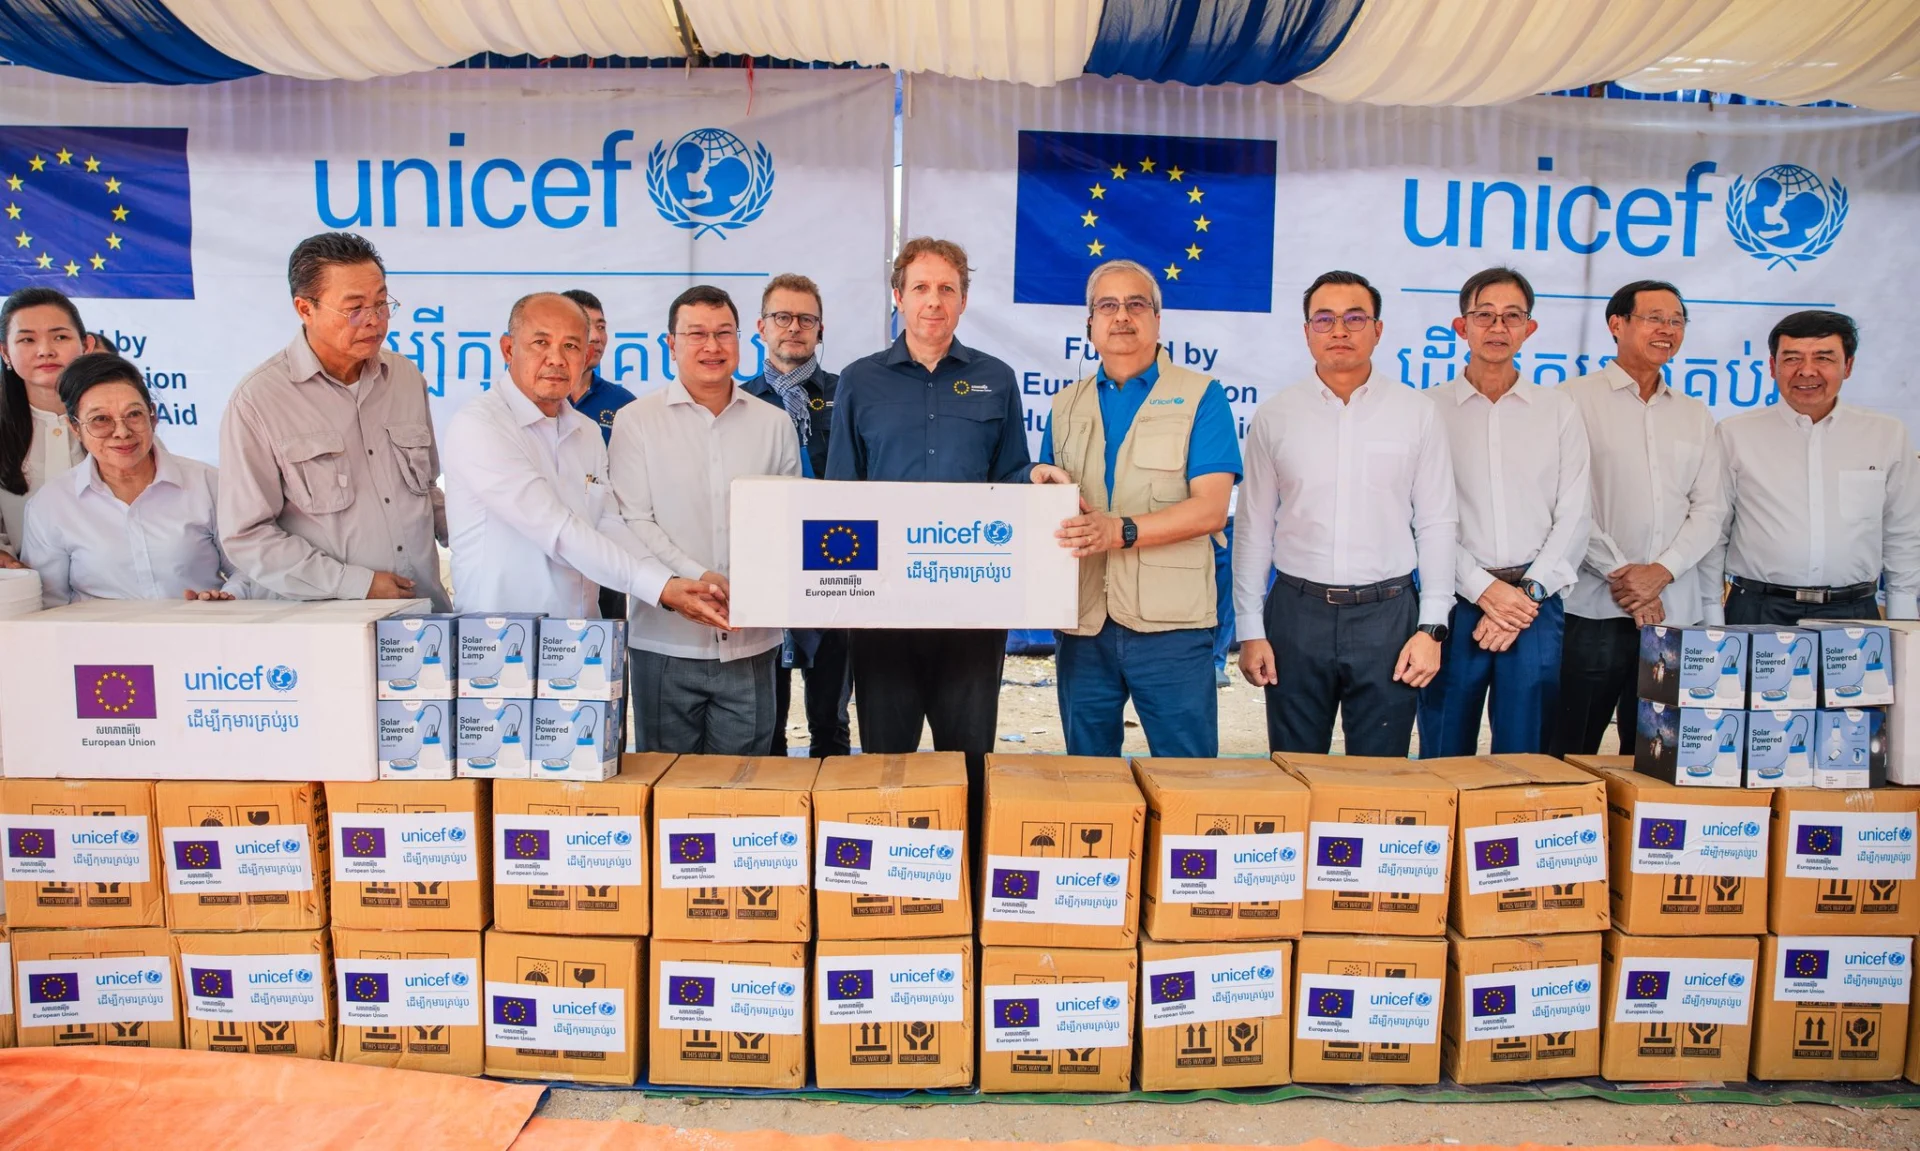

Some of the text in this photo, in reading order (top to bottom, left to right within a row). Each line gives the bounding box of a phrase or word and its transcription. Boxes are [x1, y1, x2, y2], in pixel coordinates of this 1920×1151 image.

[315, 130, 634, 229] unicef
[1403, 157, 1718, 258] unicef
[116, 330, 147, 358] by
[1185, 342, 1218, 371] by
[146, 367, 187, 389] ion
[1149, 397, 1175, 406] unicef
[157, 402, 198, 425] Aid
[907, 521, 981, 544] unicef
[907, 561, 1011, 583] ដើម្បីកុមារគ្រប់រូប
[805, 589, 847, 597] European
[462, 636, 482, 644] Solar
[543, 637, 563, 645] Solar
[462, 644, 496, 652] Powered
[542, 645, 576, 653] Powered
[1685, 648, 1703, 656] Solar
[1756, 650, 1774, 658] Solar
[380, 653, 402, 662] Lamp
[462, 652, 484, 661] Lamp
[542, 653, 564, 662] Lamp
[1755, 658, 1786, 666] Powered
[1826, 654, 1857, 662] Powered
[1684, 663, 1703, 672] Lamp
[1755, 666, 1775, 674] Lamp
[1826, 662, 1847, 670] Lamp
[184, 665, 263, 690] unicef
[187, 709, 299, 732] ដើម្បីកុមារគ្រប់រូប
[460, 716, 480, 724] Solar
[536, 717, 555, 725] Solar
[381, 726, 414, 734] Powered
[460, 724, 494, 732] Powered
[82, 738, 156, 747] European Union
[381, 734, 403, 743] Lamp
[460, 732, 482, 741] Lamp
[535, 733, 557, 742] Lamp
[1752, 736, 1782, 744] Powered
[1682, 741, 1701, 750] Lamp
[1752, 744, 1771, 752] Lamp
[401, 828, 447, 842] unicef
[1702, 821, 1743, 836] unicef
[1858, 827, 1899, 841] unicef
[72, 830, 119, 844] unicef
[566, 831, 612, 845] unicef
[732, 832, 778, 847] unicef
[1535, 831, 1578, 849] unicef
[235, 840, 281, 855] unicef
[889, 843, 936, 859] unicef
[1379, 840, 1423, 855] unicef
[1233, 848, 1278, 863] unicef
[825, 877, 851, 885] European
[1056, 873, 1102, 887] unicef
[1479, 878, 1504, 886] European
[992, 907, 1019, 915] European
[1845, 951, 1887, 965] unicef
[96, 970, 143, 985] unicef
[248, 969, 294, 983] unicef
[405, 972, 450, 987] unicef
[890, 968, 936, 983] unicef
[1211, 966, 1256, 983] unicef
[1684, 972, 1727, 986] unicef
[731, 981, 776, 995] unicef
[1531, 981, 1573, 997] unicef
[1056, 996, 1101, 1012] unicef
[1370, 992, 1414, 1006] unicef
[553, 1002, 597, 1015] unicef
[1153, 1012, 1179, 1020] European
